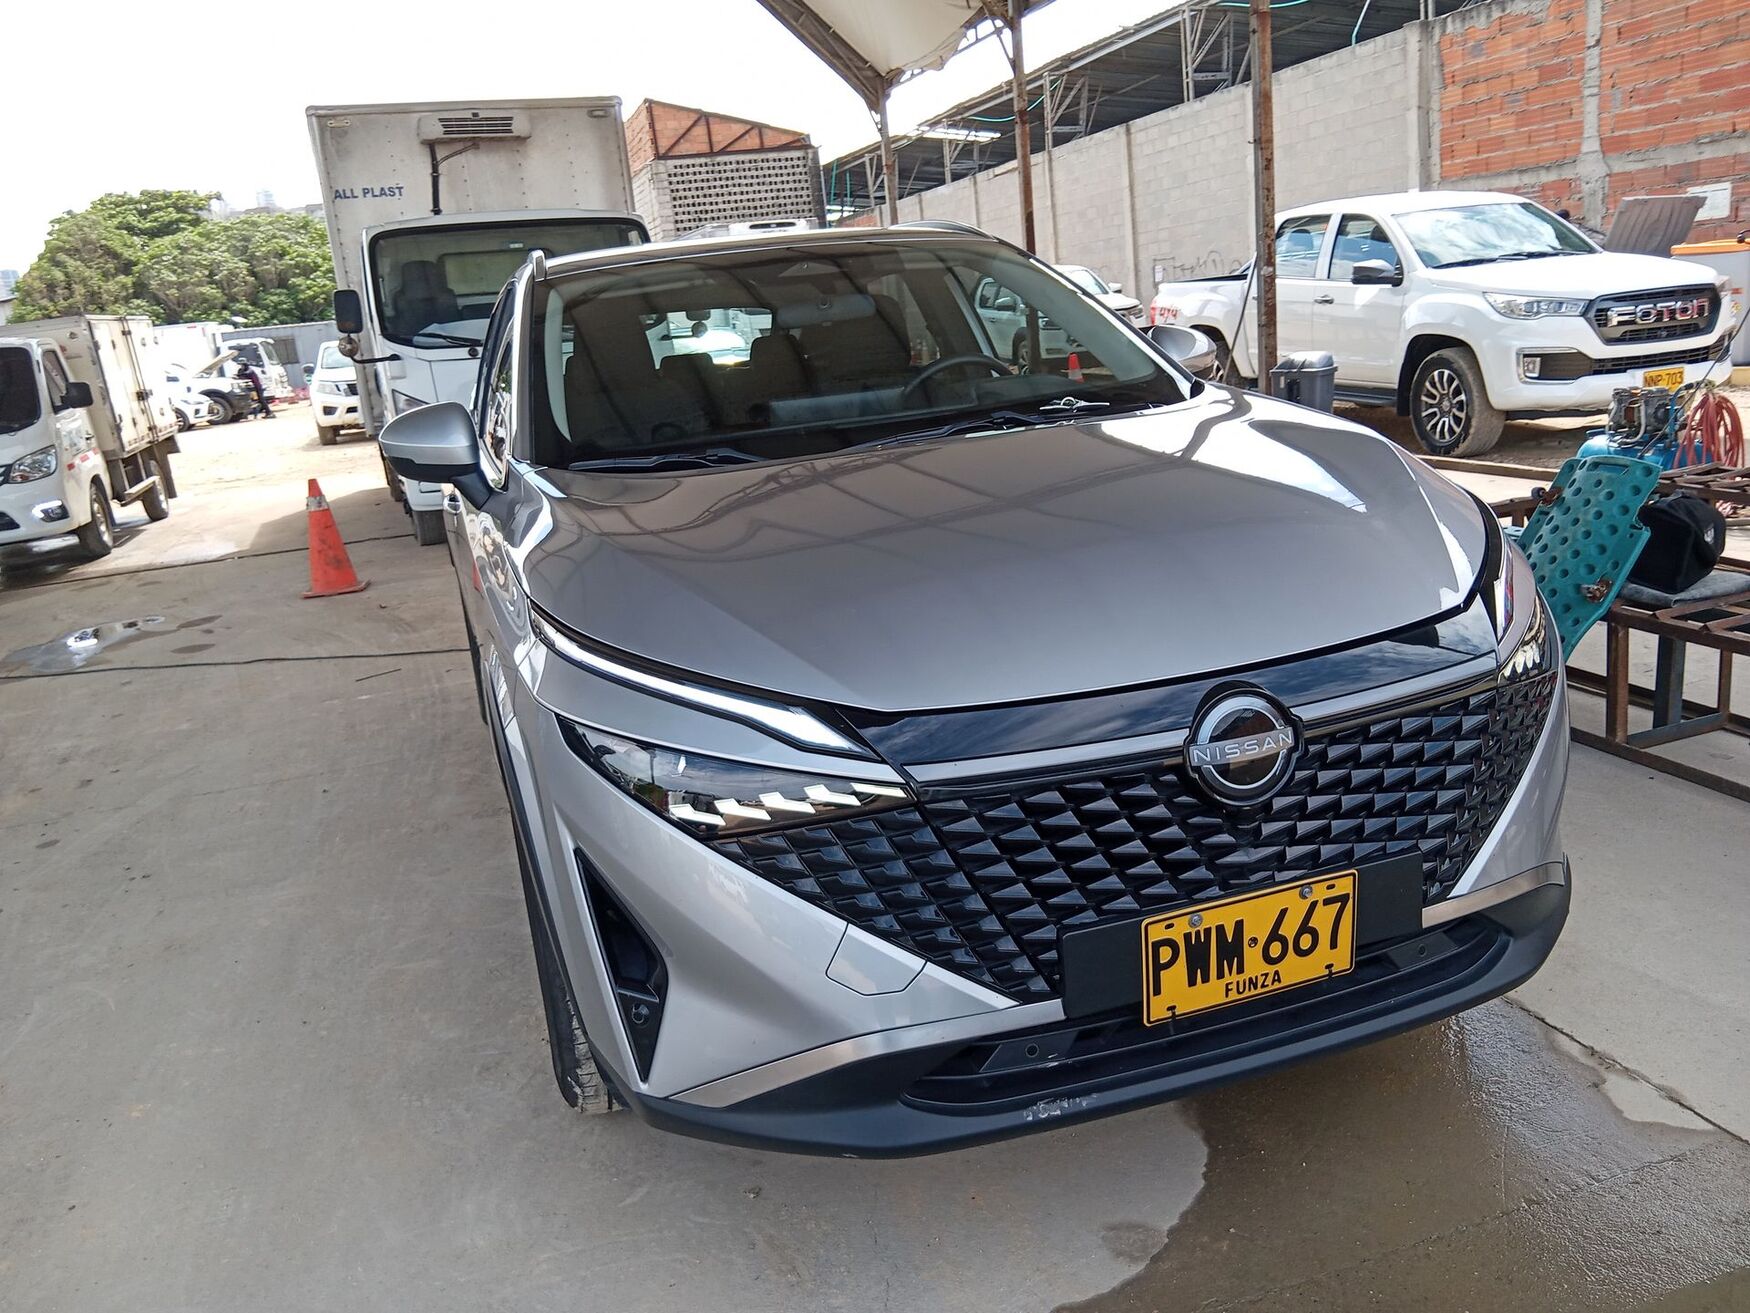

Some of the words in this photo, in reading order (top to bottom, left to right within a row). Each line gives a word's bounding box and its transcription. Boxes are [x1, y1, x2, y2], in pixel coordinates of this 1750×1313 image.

[334, 188, 359, 200] ALL
[362, 186, 404, 198] PLAST
[1607, 298, 1710, 328] FOTON
[1193, 730, 1293, 763] NISSAN
[1224, 969, 1282, 998] FUNZA
